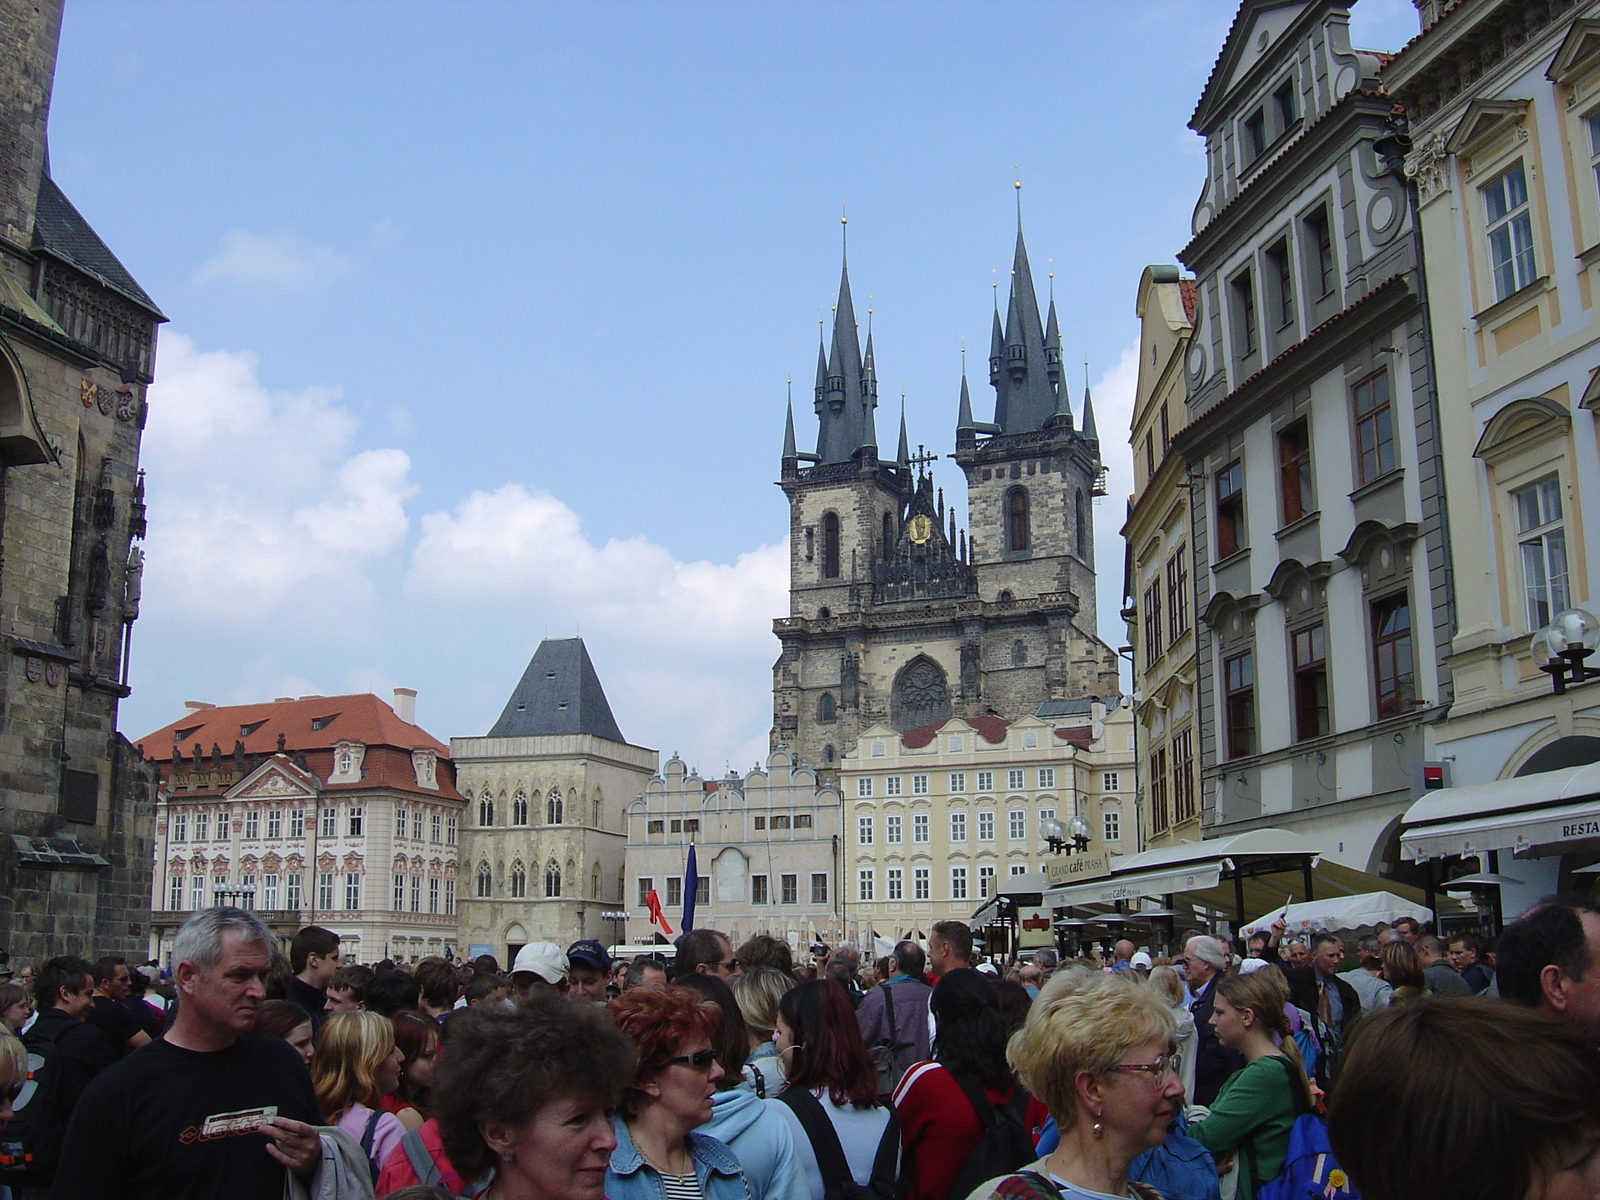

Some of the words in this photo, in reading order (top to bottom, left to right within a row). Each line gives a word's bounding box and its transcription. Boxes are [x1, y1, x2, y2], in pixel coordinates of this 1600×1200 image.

[1563, 821, 1600, 837] RESTA
[1051, 865, 1068, 877] GRAND
[1069, 858, 1084, 873] café
[1084, 859, 1102, 871] PRAHA
[1112, 885, 1126, 898] café
